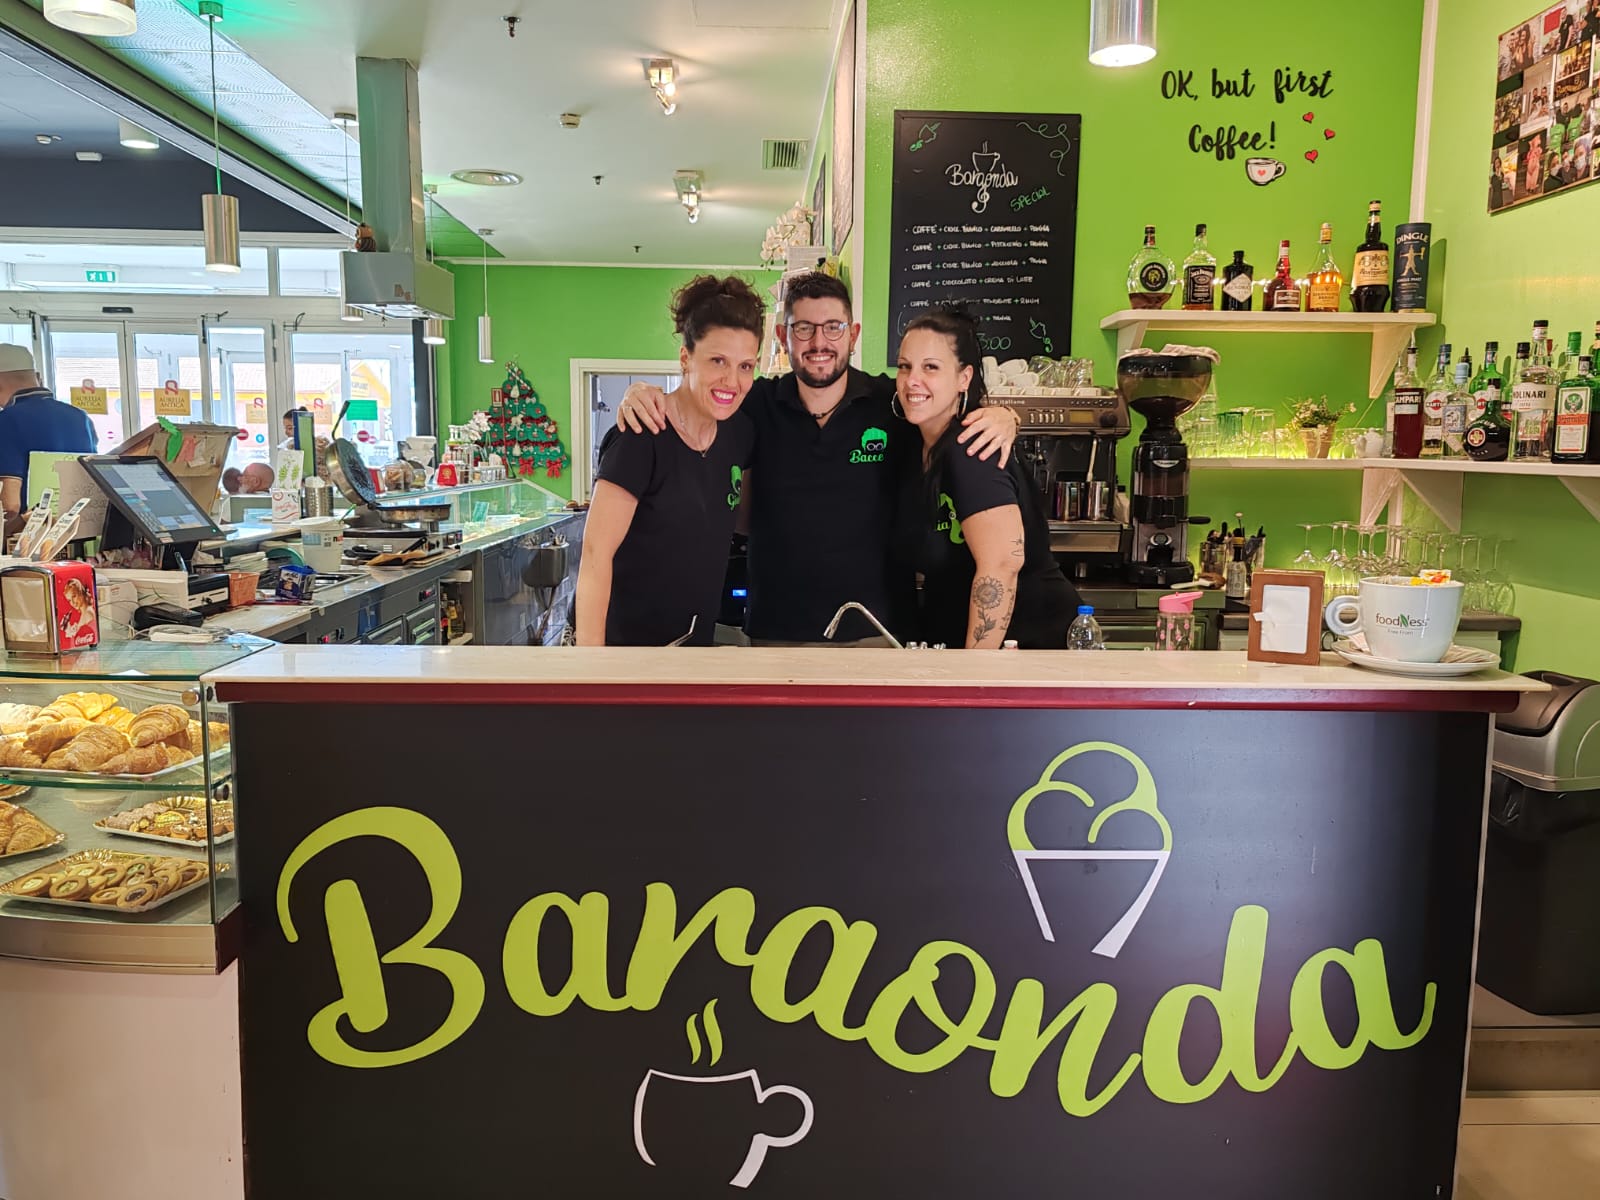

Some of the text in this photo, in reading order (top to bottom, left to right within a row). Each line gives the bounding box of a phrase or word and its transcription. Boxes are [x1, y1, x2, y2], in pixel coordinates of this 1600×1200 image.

[1161, 66, 1334, 104] OK, but first
[1188, 120, 1276, 161] Coffee!
[945, 163, 1019, 188] Baraonda
[1010, 186, 1051, 212] SPECIAL
[1396, 232, 1429, 245] DINGLE
[1395, 395, 1421, 404] AMPARI
[849, 449, 884, 464] Bacce
[277, 806, 1438, 1118] Baraonda
